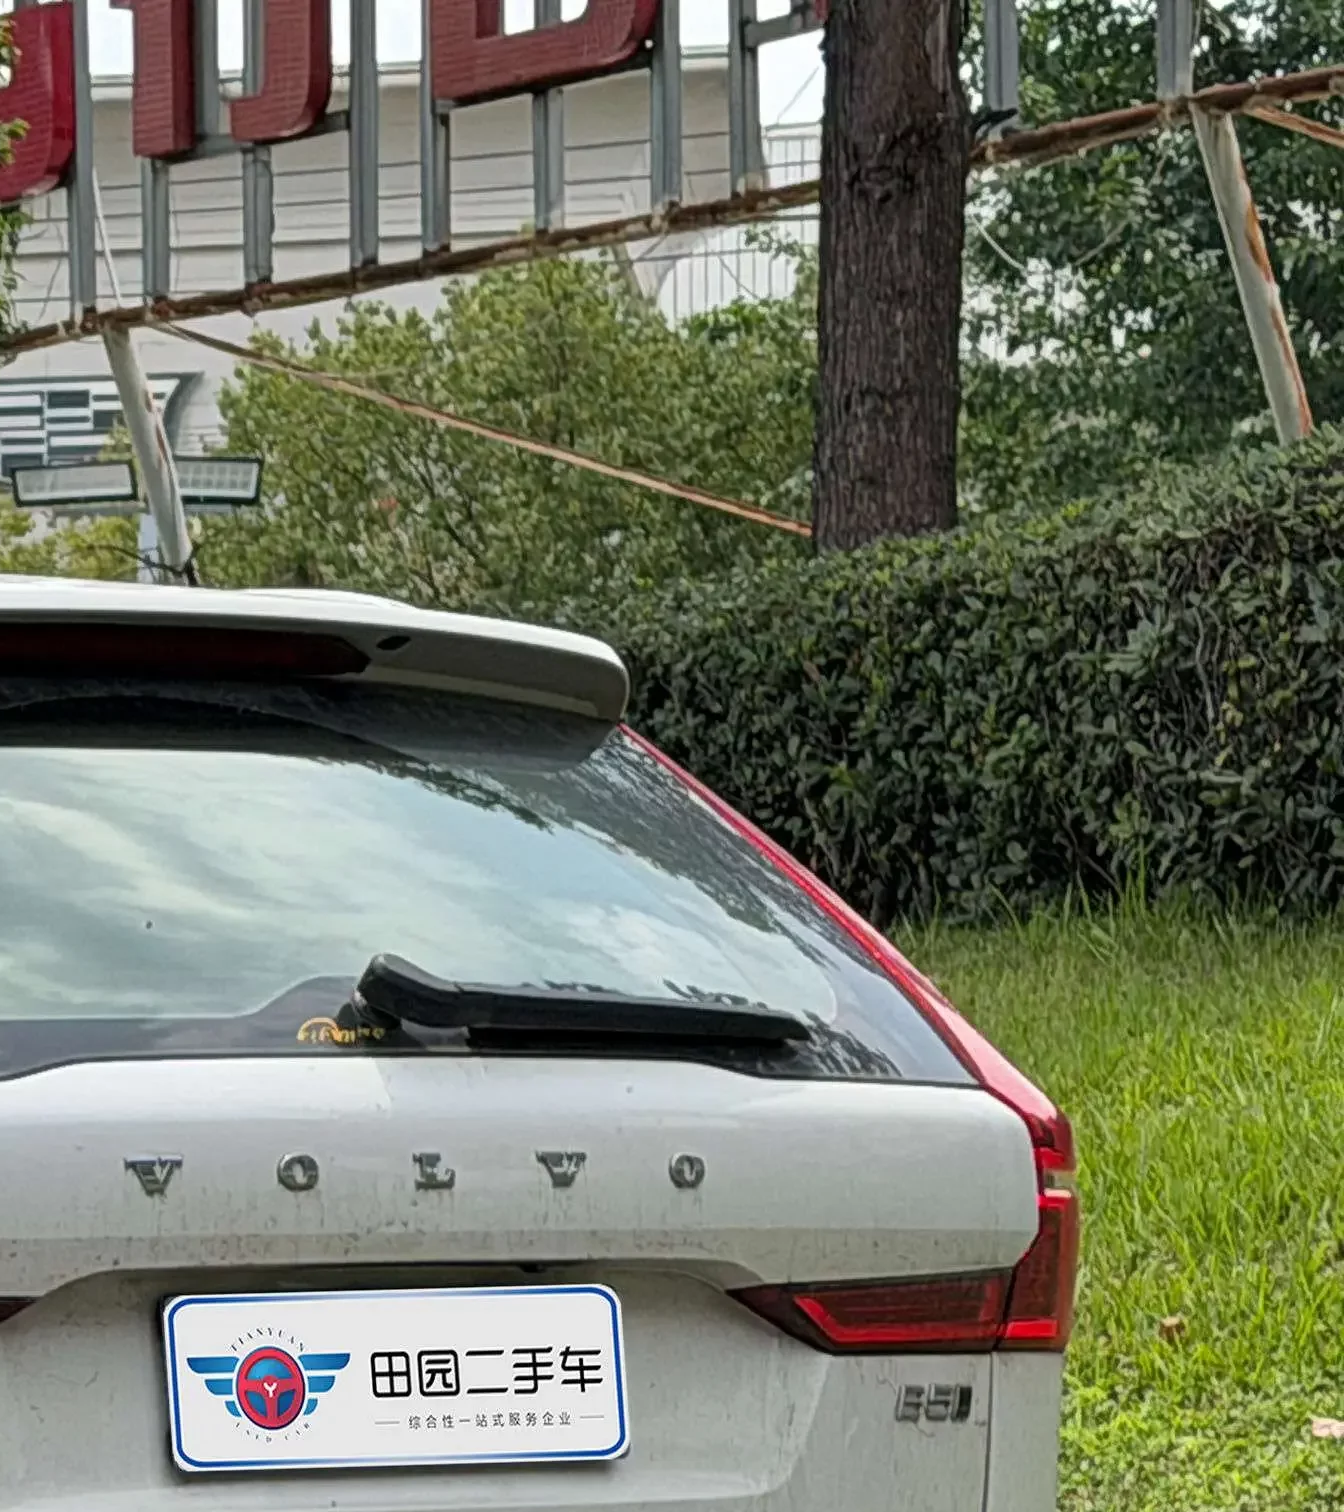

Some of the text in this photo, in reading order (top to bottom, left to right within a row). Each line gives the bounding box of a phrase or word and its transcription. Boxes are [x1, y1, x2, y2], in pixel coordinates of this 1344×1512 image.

[123, 1151, 706, 1196] VOLVO
[370, 1346, 604, 1398] 田园二手车
[408, 1411, 572, 1430] 综合性一站式服务企业
